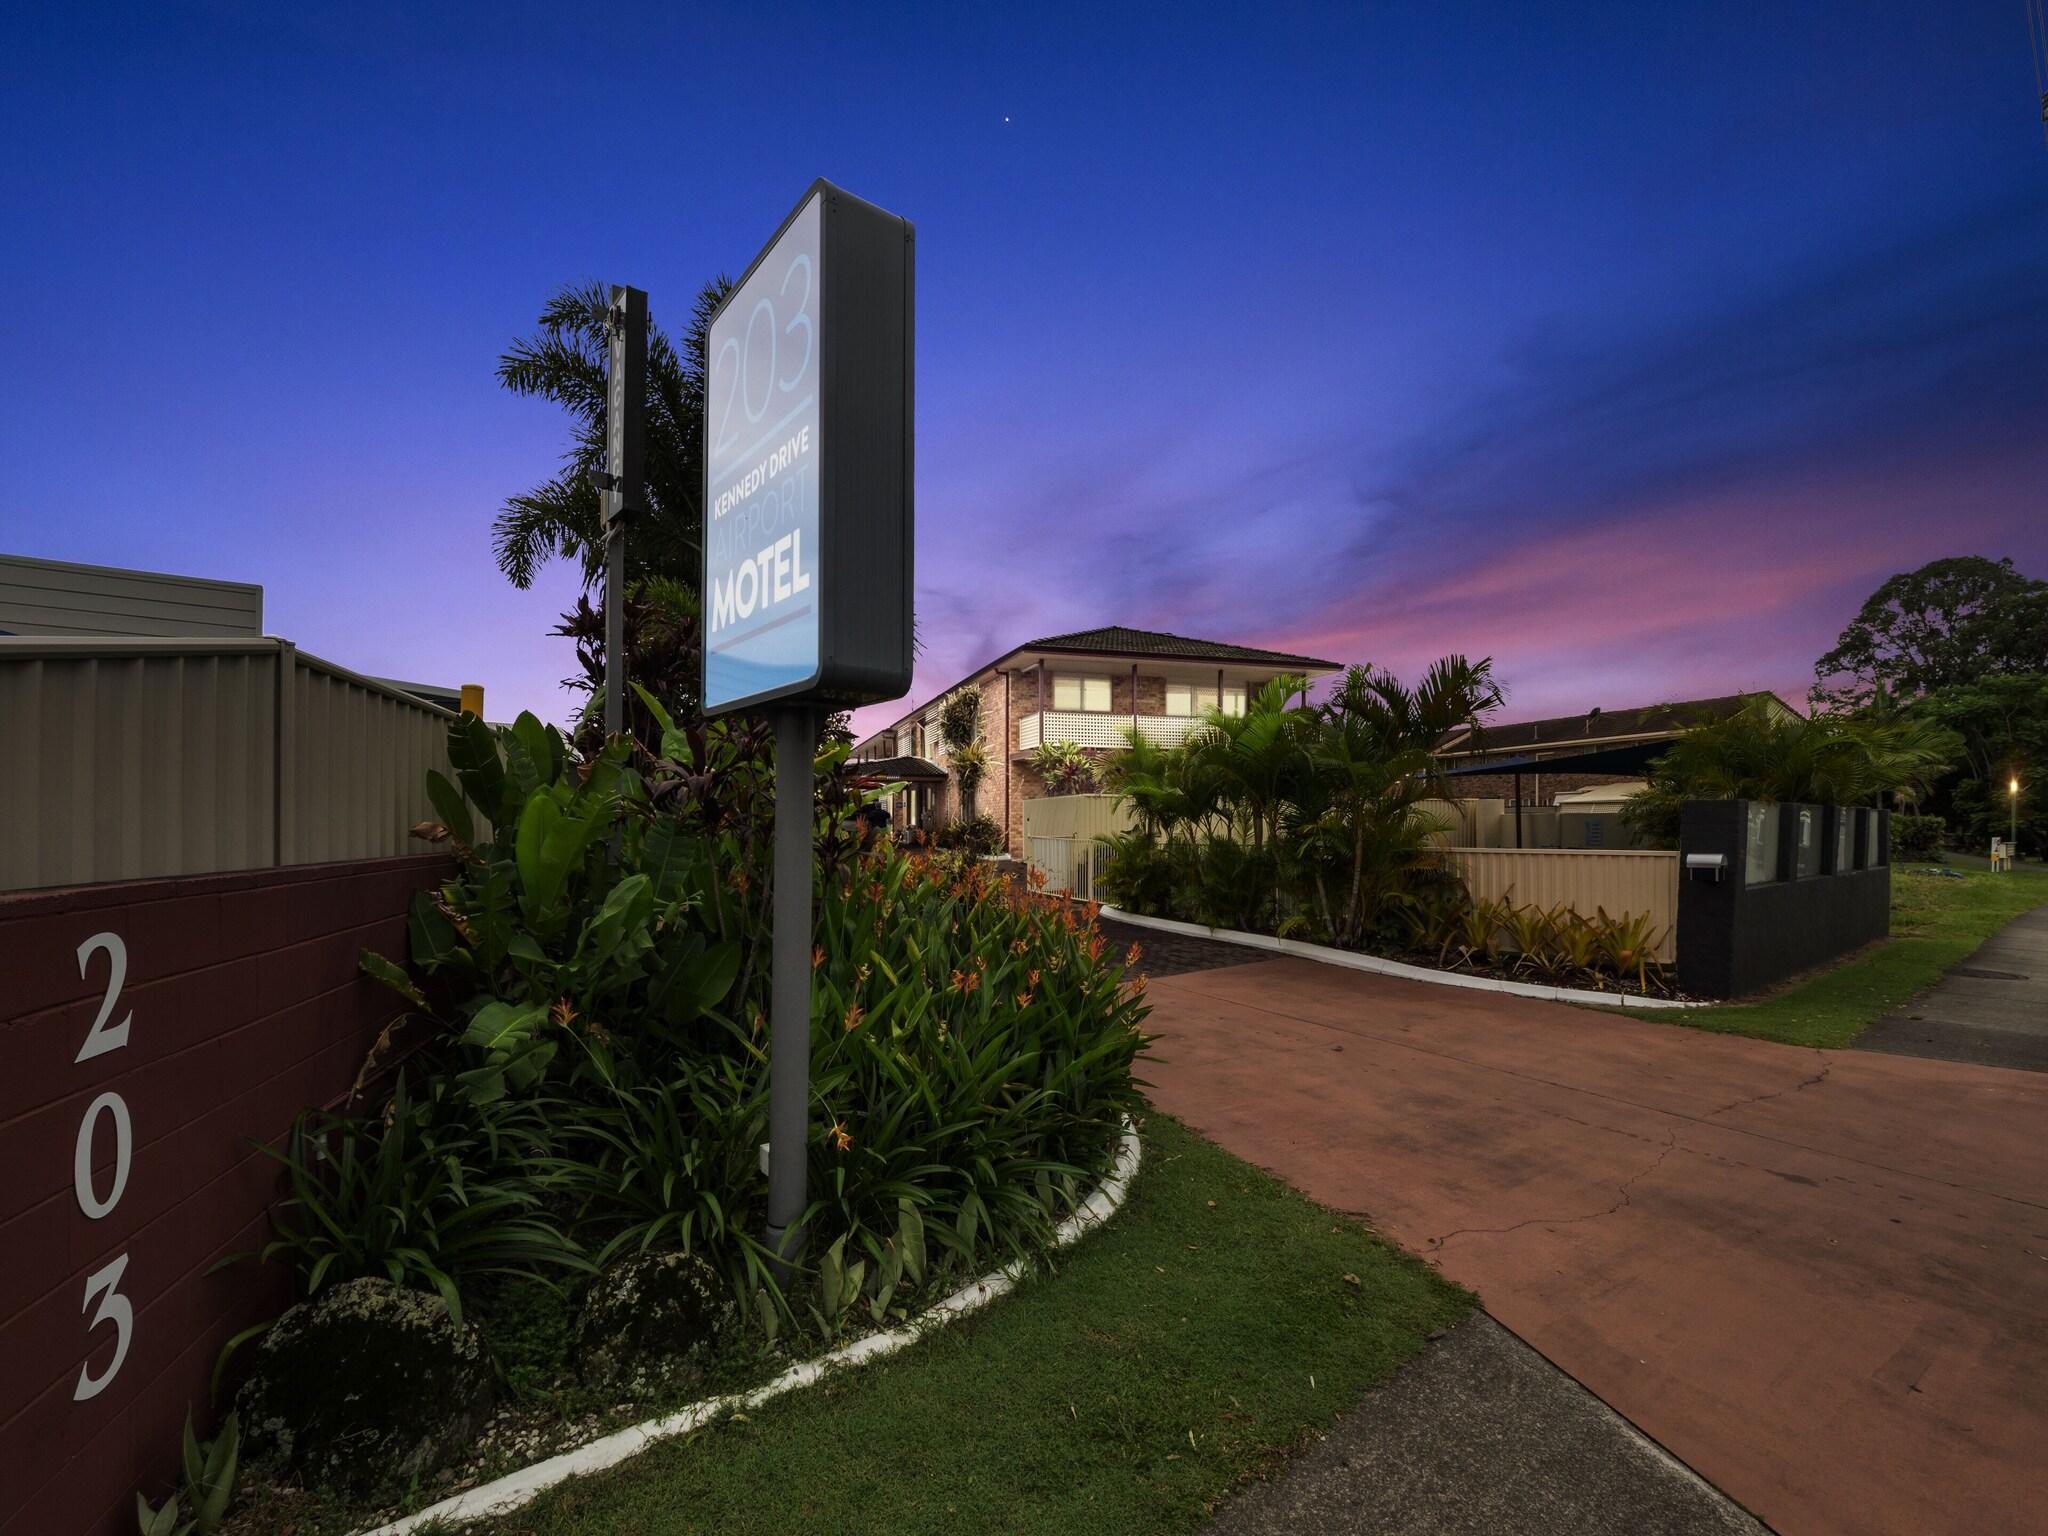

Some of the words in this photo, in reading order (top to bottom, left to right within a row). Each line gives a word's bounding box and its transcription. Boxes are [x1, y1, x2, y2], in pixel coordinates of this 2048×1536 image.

[612, 341, 622, 503] VACANCY
[714, 254, 813, 458] 203
[714, 460, 768, 520] KENNEDY
[769, 425, 809, 479] DRIVE
[714, 464, 809, 565] AIRPORT
[711, 528, 810, 632] MOTEL
[74, 931, 133, 1402] 203
